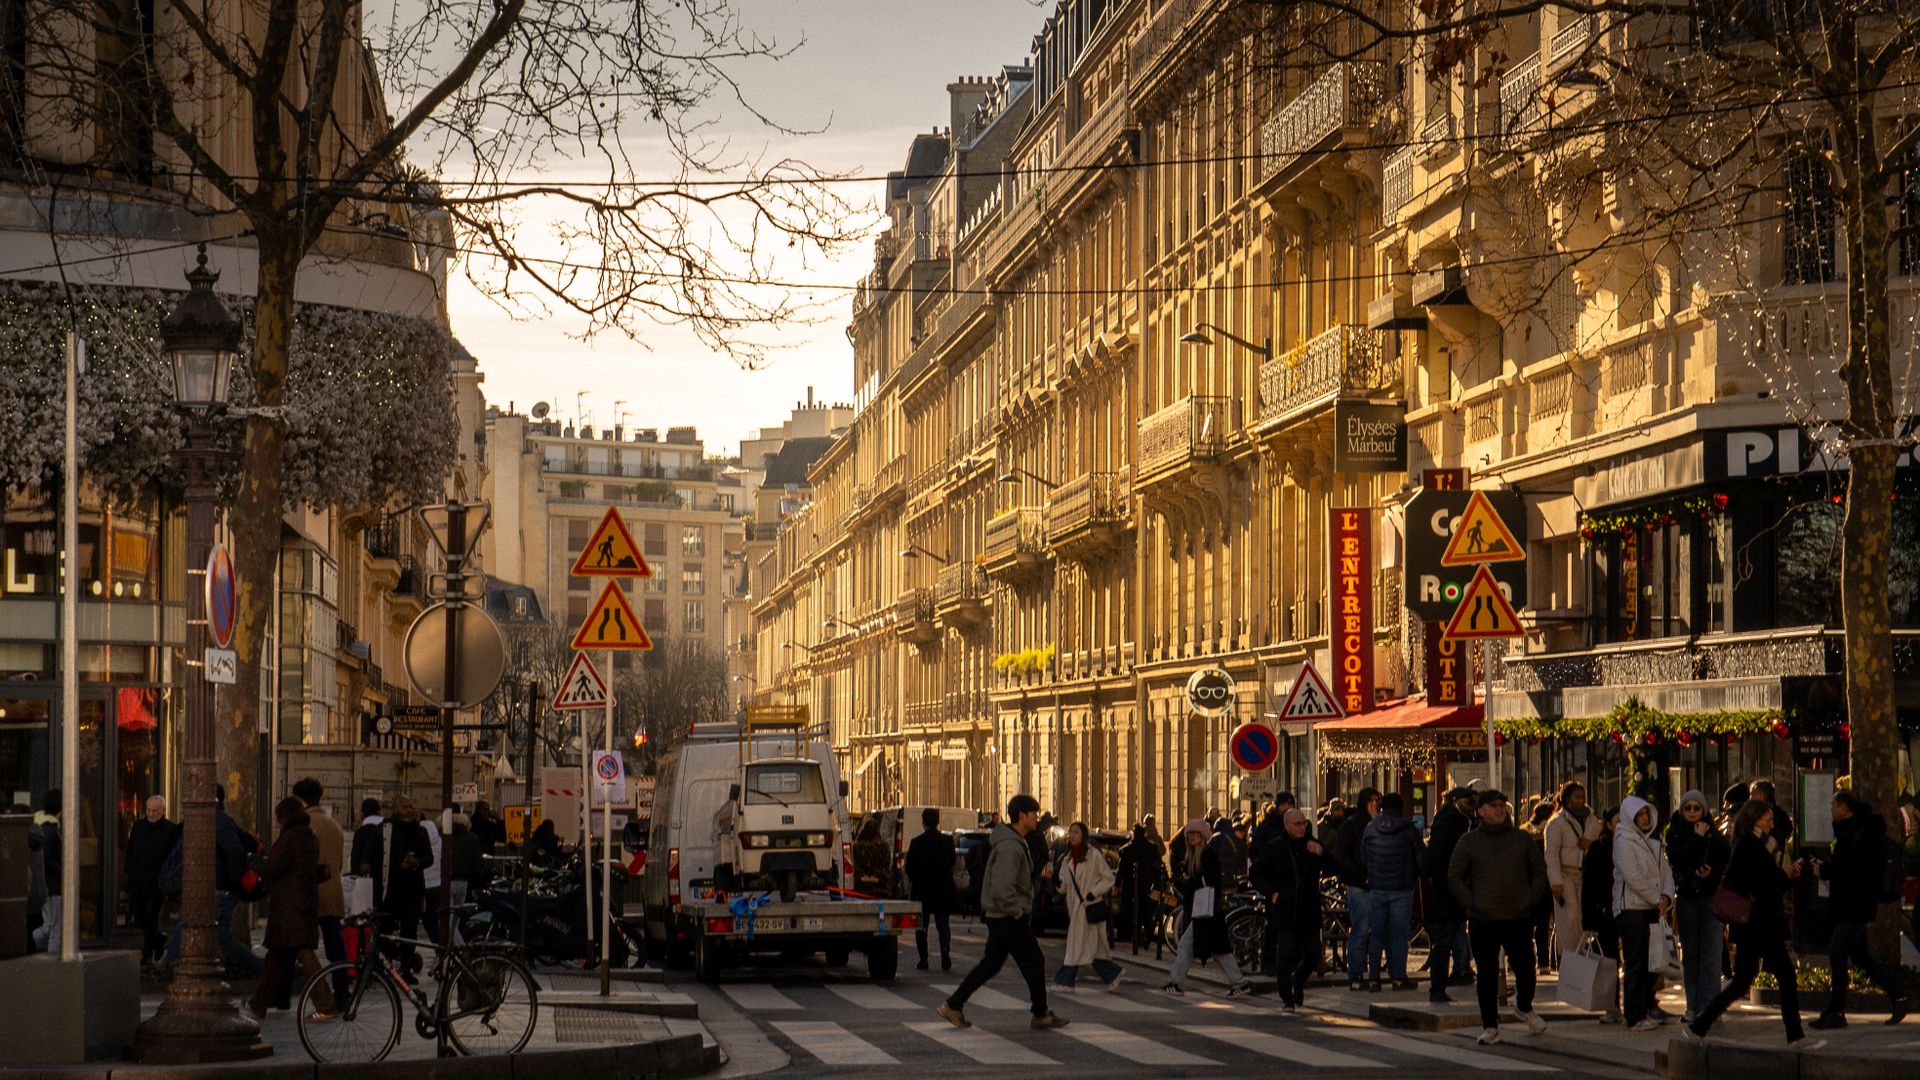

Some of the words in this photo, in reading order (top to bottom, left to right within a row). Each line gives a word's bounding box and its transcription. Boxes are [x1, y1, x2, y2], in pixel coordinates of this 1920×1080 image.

[1347, 414, 1397, 441] Élysées
[1347, 436, 1397, 453] Marbeuf
[1340, 512, 1363, 713] L'ENTRECOTE
